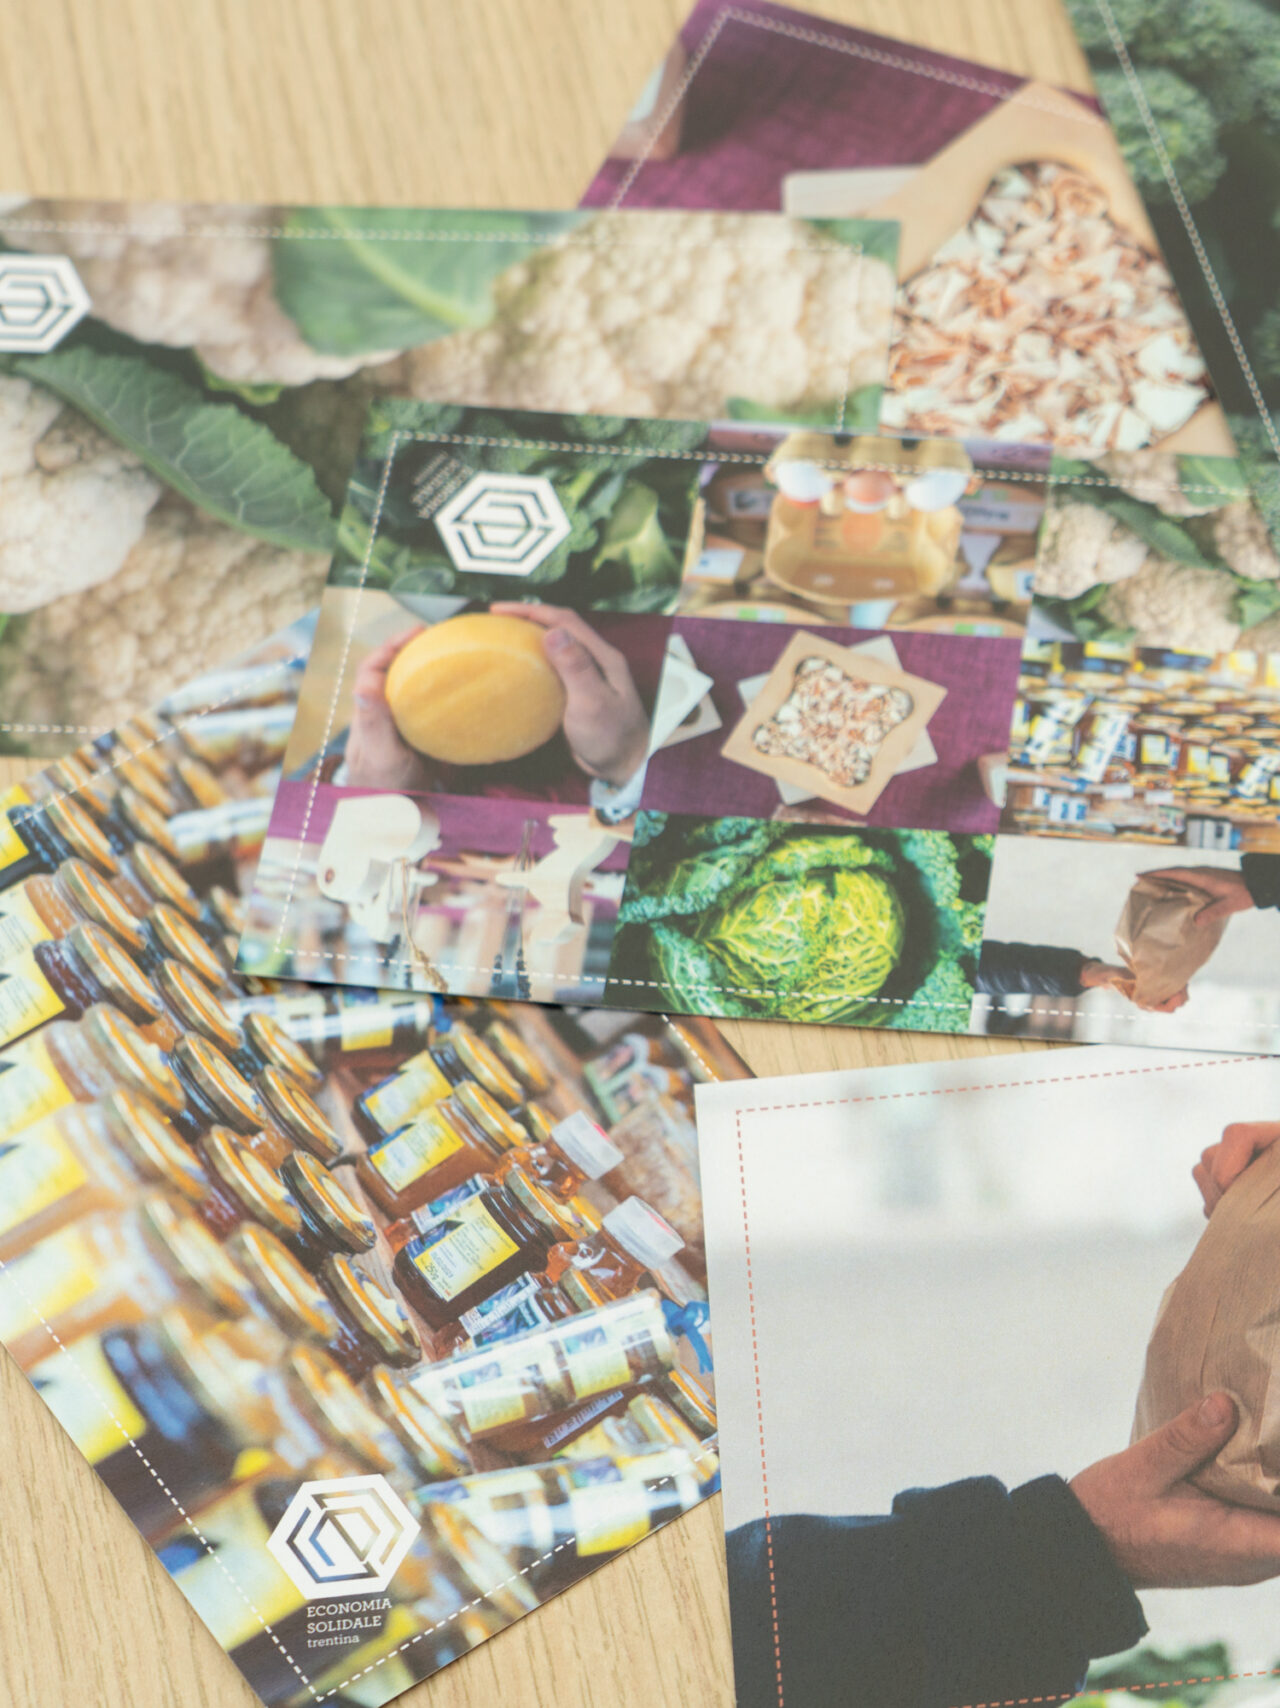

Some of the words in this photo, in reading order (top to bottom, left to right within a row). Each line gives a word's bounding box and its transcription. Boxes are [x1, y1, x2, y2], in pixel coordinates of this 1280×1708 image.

[306, 1598, 393, 1618] ECONOMIA
[306, 1615, 382, 1634] SOLIDALE
[307, 1633, 360, 1649] trentina
